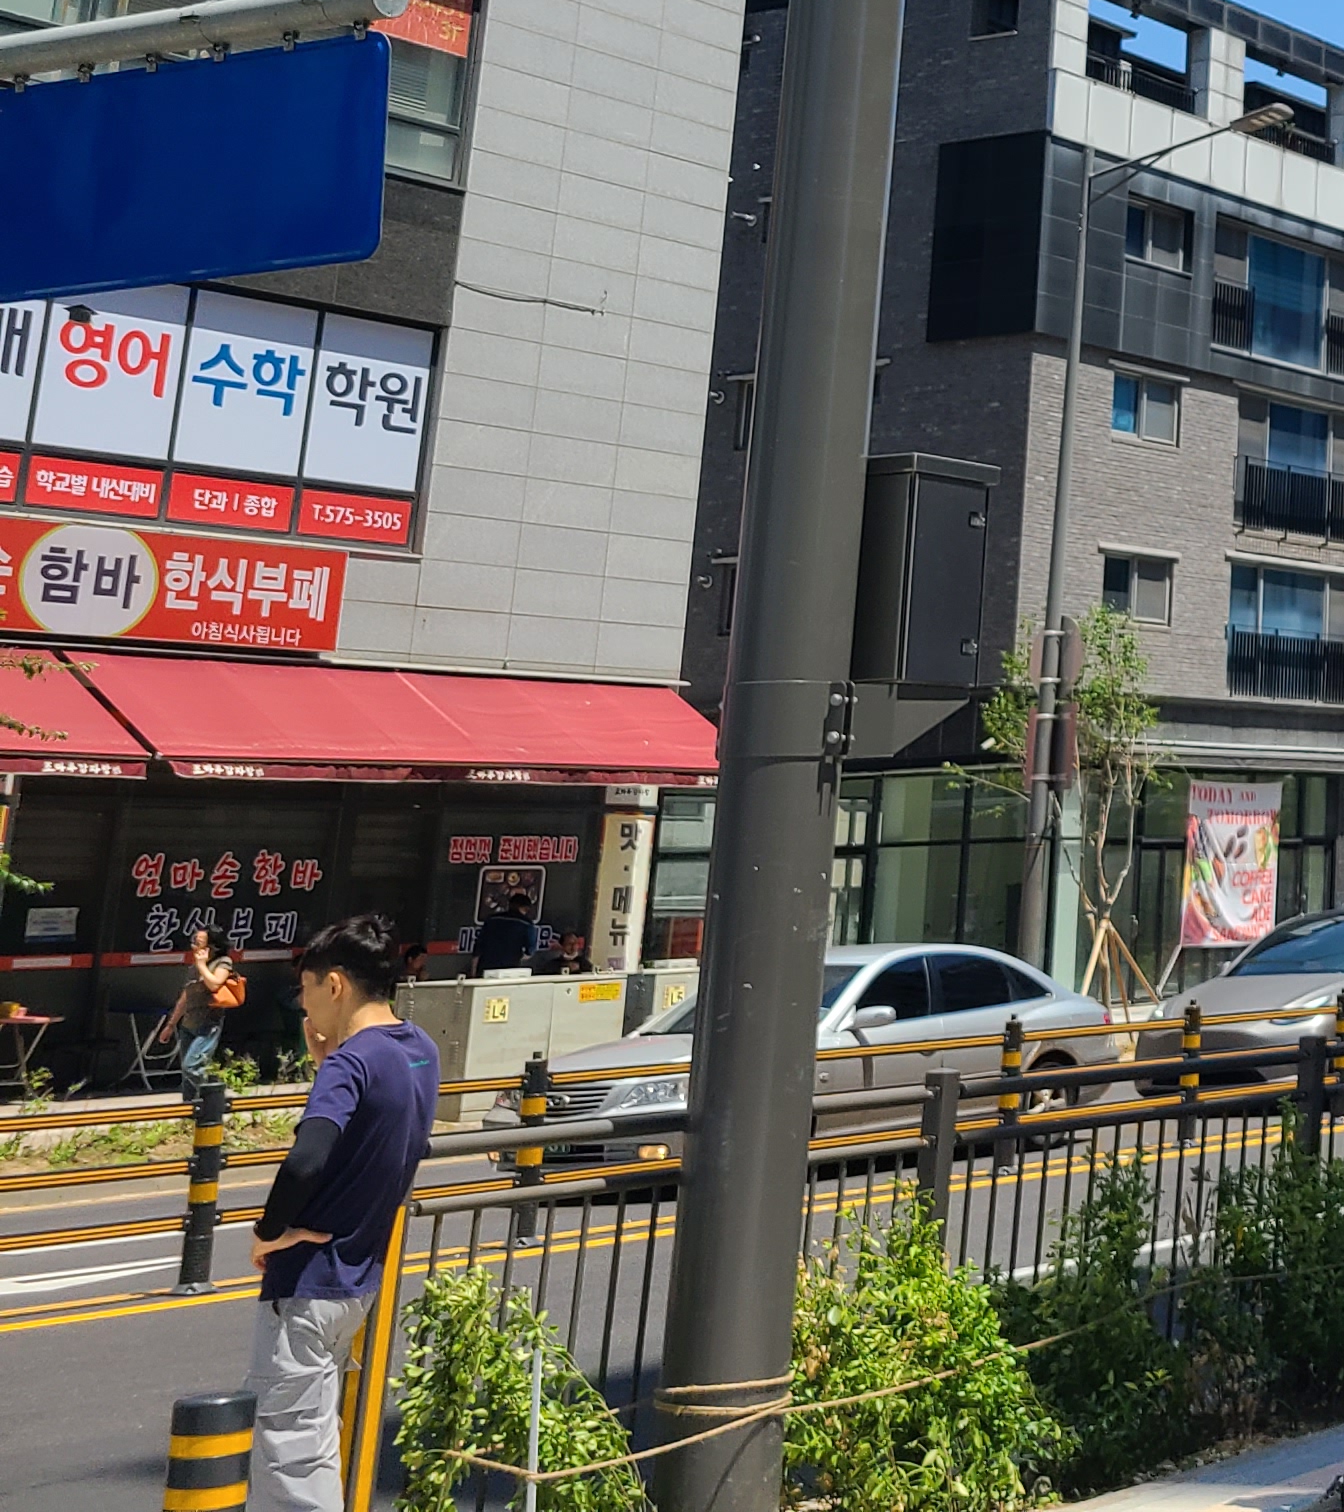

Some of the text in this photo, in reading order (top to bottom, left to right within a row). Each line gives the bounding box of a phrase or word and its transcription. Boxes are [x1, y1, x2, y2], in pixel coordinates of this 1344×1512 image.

[59, 320, 172, 399] 영어
[191, 343, 306, 417] 수학
[326, 361, 424, 435] 학원
[35, 469, 88, 493] 학교별
[91, 476, 157, 504] 내신대비
[192, 488, 229, 512] 단과
[243, 494, 279, 518] 종합
[311, 502, 403, 530] T.575-3505
[40, 546, 141, 610] 함바
[164, 551, 331, 622] 한식부페
[191, 620, 302, 647] 아침식사됩니다
[1191, 784, 1257, 804] TODAY AND
[498, 835, 579, 864] 준비했습니다
[253, 848, 322, 896] 함바
[491, 1004, 507, 1020] L4
